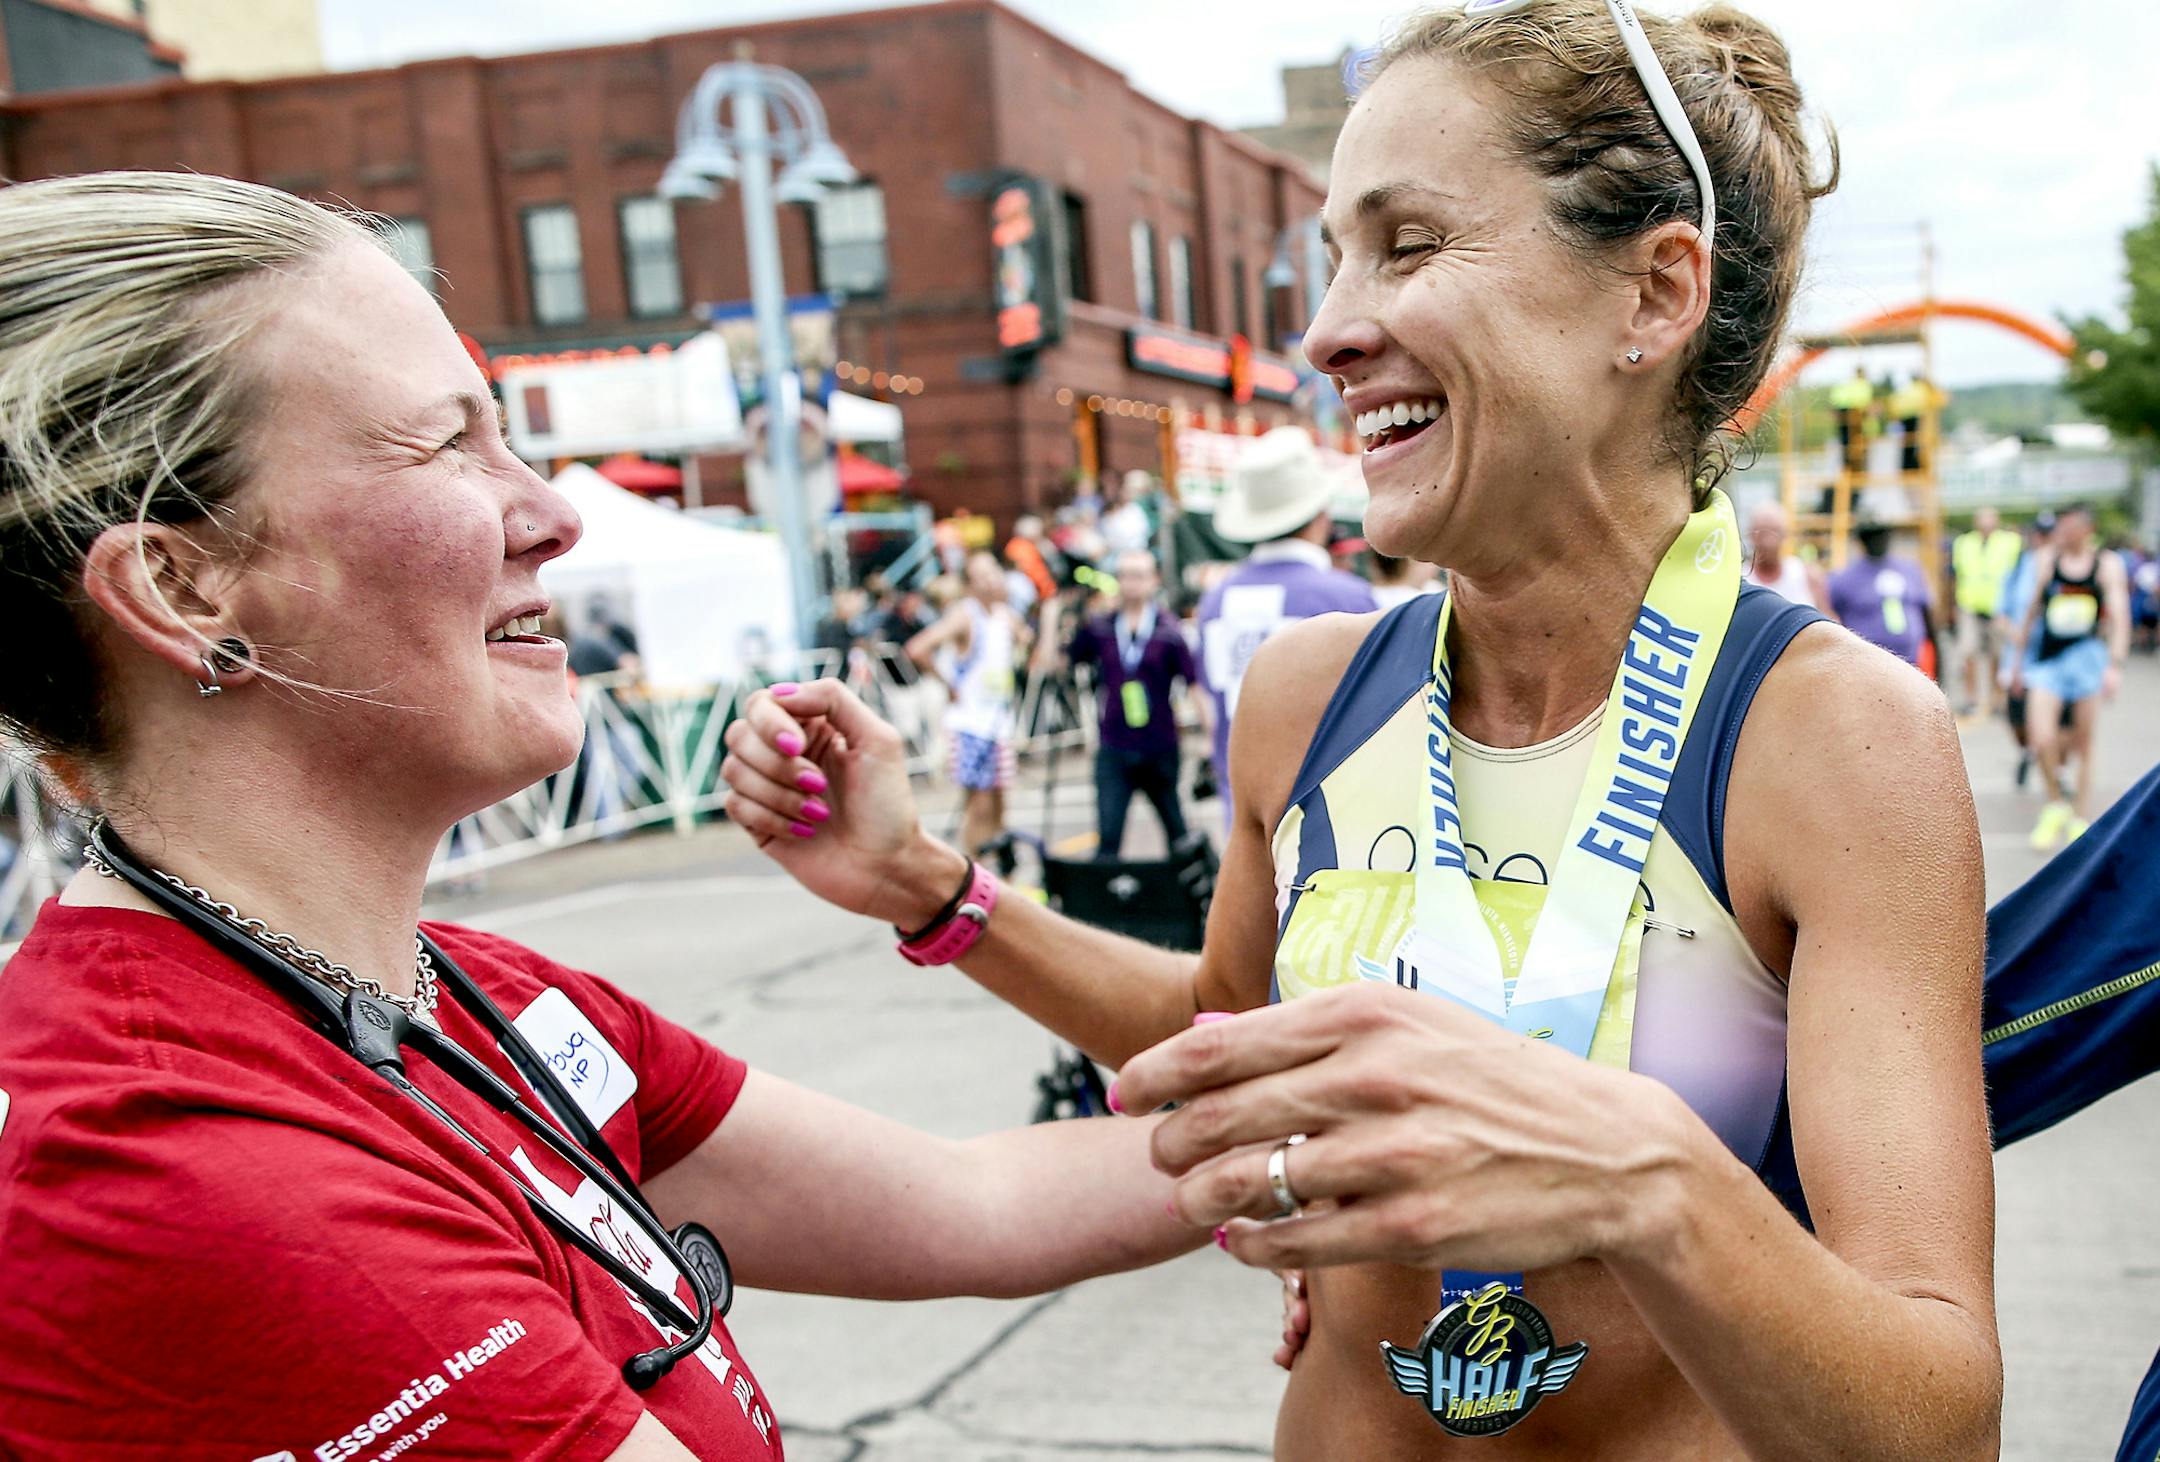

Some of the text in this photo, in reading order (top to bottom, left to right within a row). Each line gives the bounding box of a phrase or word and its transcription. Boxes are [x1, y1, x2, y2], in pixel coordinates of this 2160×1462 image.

[1577, 602, 1701, 875] FINISHER
[313, 1317, 527, 1462] Essentia Health
[1431, 1345, 1550, 1411] HALF
[1445, 1389, 1521, 1420] FINISHER
[379, 1412, 449, 1461] with you
